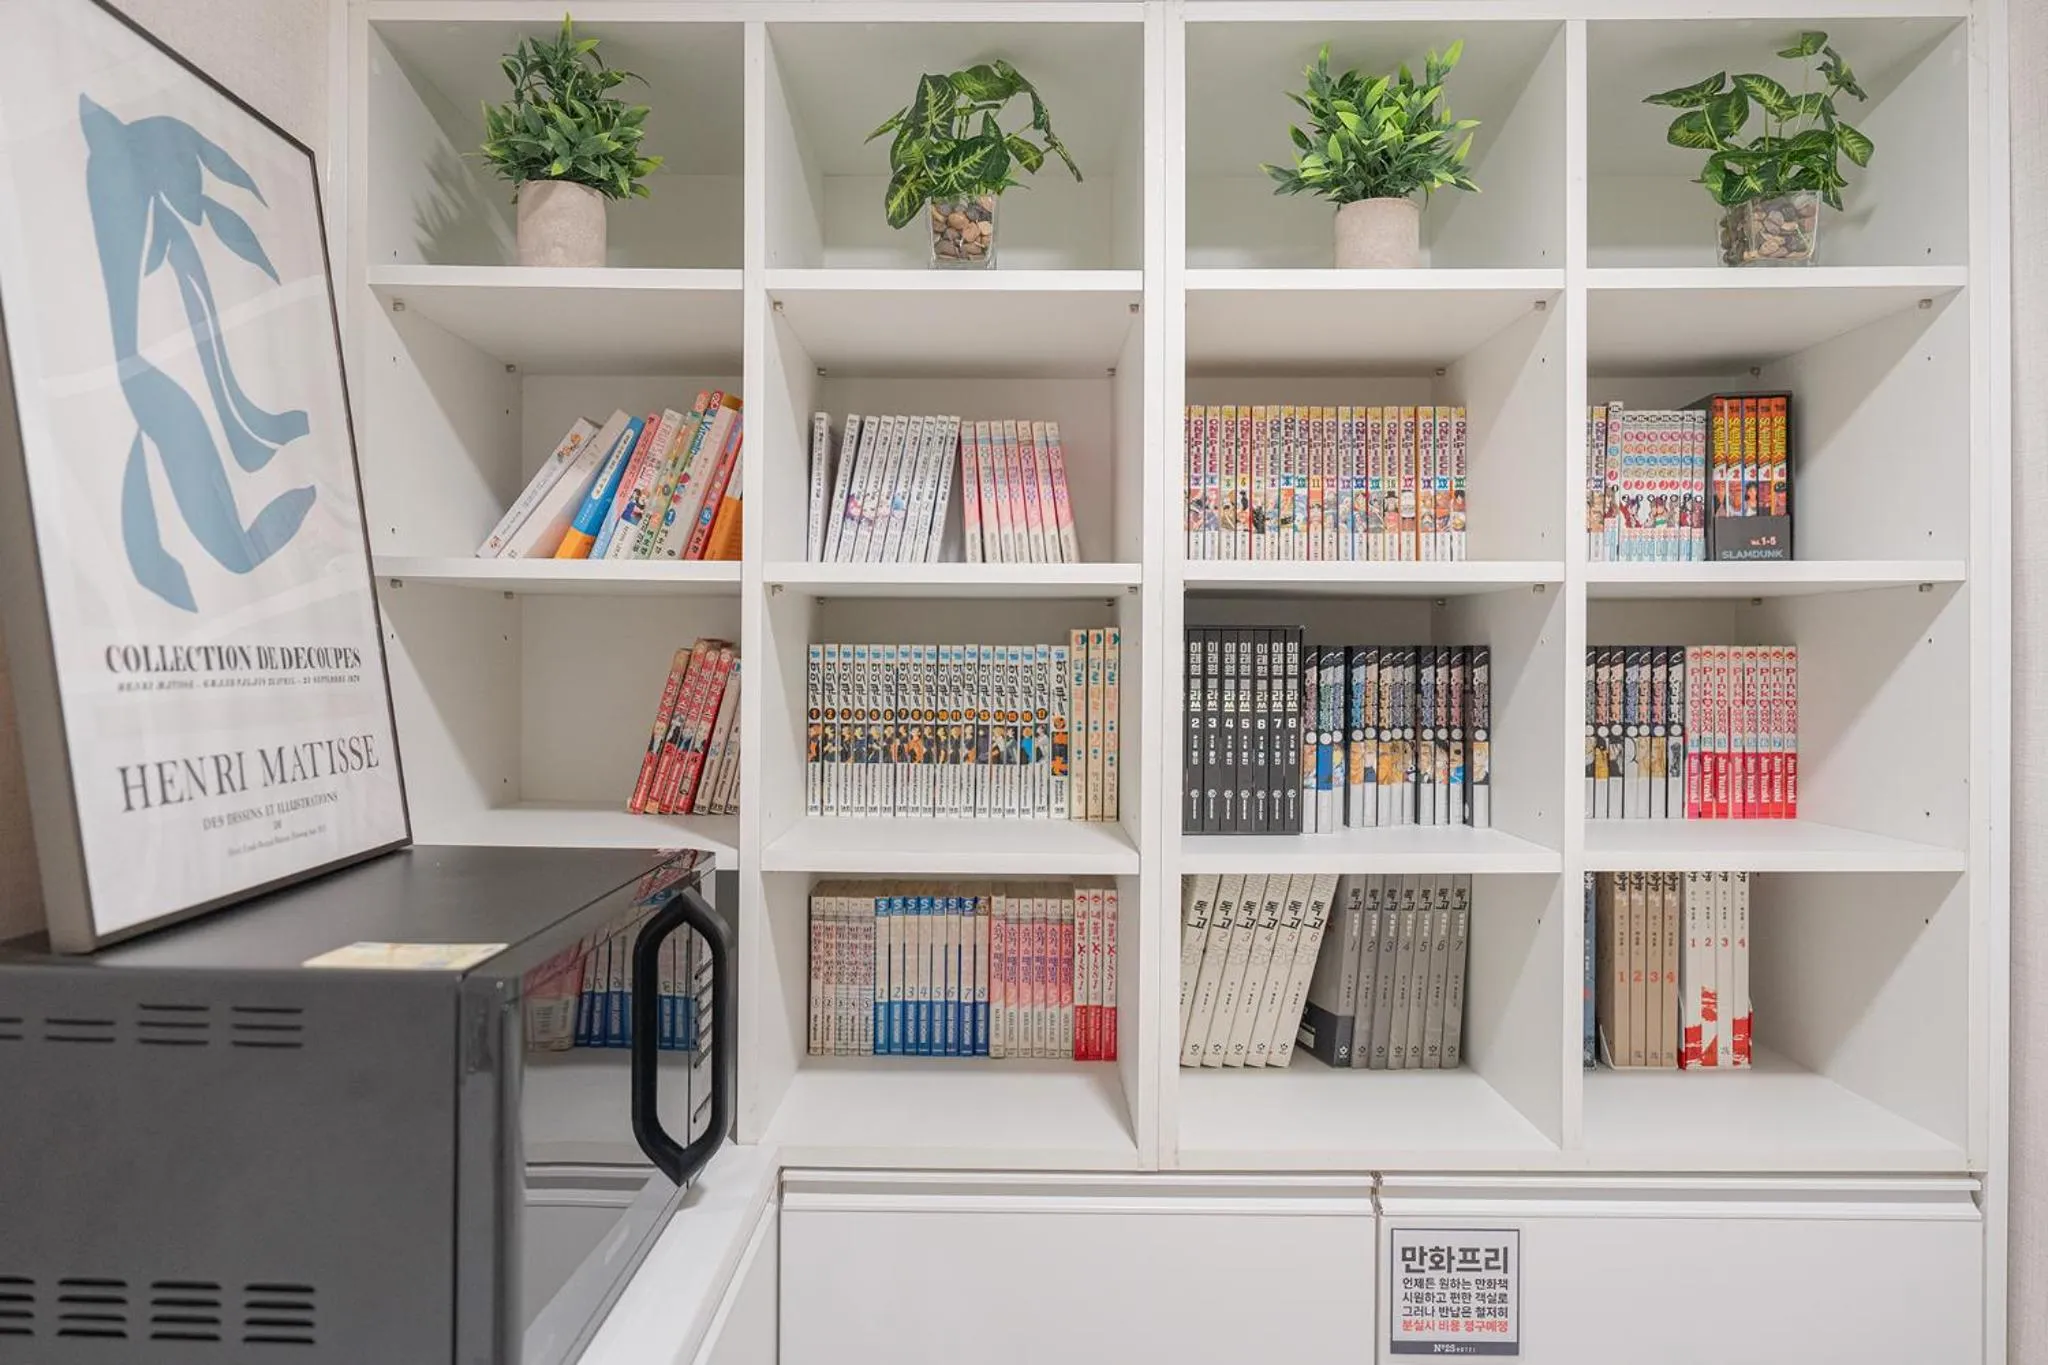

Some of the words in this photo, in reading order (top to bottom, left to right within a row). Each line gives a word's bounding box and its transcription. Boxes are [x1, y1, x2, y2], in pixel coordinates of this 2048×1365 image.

[1733, 469, 1740, 478] 2
[1311, 478, 1321, 488] 11
[1722, 549, 1783, 559] SLAMDUNK
[105, 644, 252, 673] COLLECTION
[258, 647, 279, 669] DE
[282, 647, 361, 669] DECOUPES
[1191, 718, 1199, 728] 2
[1208, 718, 1217, 728] 3
[1225, 718, 1234, 729] 4
[1241, 719, 1250, 729] 5
[1273, 718, 1282, 729] 7
[1288, 718, 1297, 728] 8
[118, 750, 248, 813] HENRI
[259, 734, 380, 789] MATISSE
[1218, 933, 1228, 942] 2
[1310, 932, 1319, 942] 6
[1704, 938, 1712, 947] 2
[1721, 938, 1729, 947] 3
[1367, 941, 1375, 952] 2
[1420, 941, 1428, 952] 5
[1437, 941, 1447, 951] 6
[1455, 941, 1463, 952] 7
[1690, 938, 1696, 948] 1
[1737, 938, 1745, 948] 4
[1618, 971, 1625, 982] 1
[1633, 971, 1643, 982] 2
[1650, 971, 1659, 982] 3
[1666, 972, 1674, 983] 4
[878, 988, 884, 998] 1
[893, 987, 901, 998] 2
[907, 987, 914, 998] 3
[920, 987, 928, 997] 4
[934, 988, 941, 998] 5
[947, 987, 955, 997] 6
[964, 988, 971, 999] 7
[977, 987, 985, 998] 8
[1401, 1246, 1508, 1274] 만화프리
[1402, 1277, 1436, 1289] 언제든
[1439, 1278, 1472, 1290] 원하는
[1475, 1278, 1508, 1290] 만화책
[1402, 1292, 1446, 1304] 시원하고
[1450, 1292, 1472, 1304] 편한
[1475, 1292, 1508, 1304] 객실로
[1402, 1306, 1435, 1318] 그러나
[1439, 1306, 1472, 1318] 반납은
[1475, 1306, 1508, 1318] 철저히
[1402, 1320, 1435, 1332] 분실시
[1439, 1320, 1461, 1332] 비용
[1464, 1320, 1508, 1333] 청구예정
